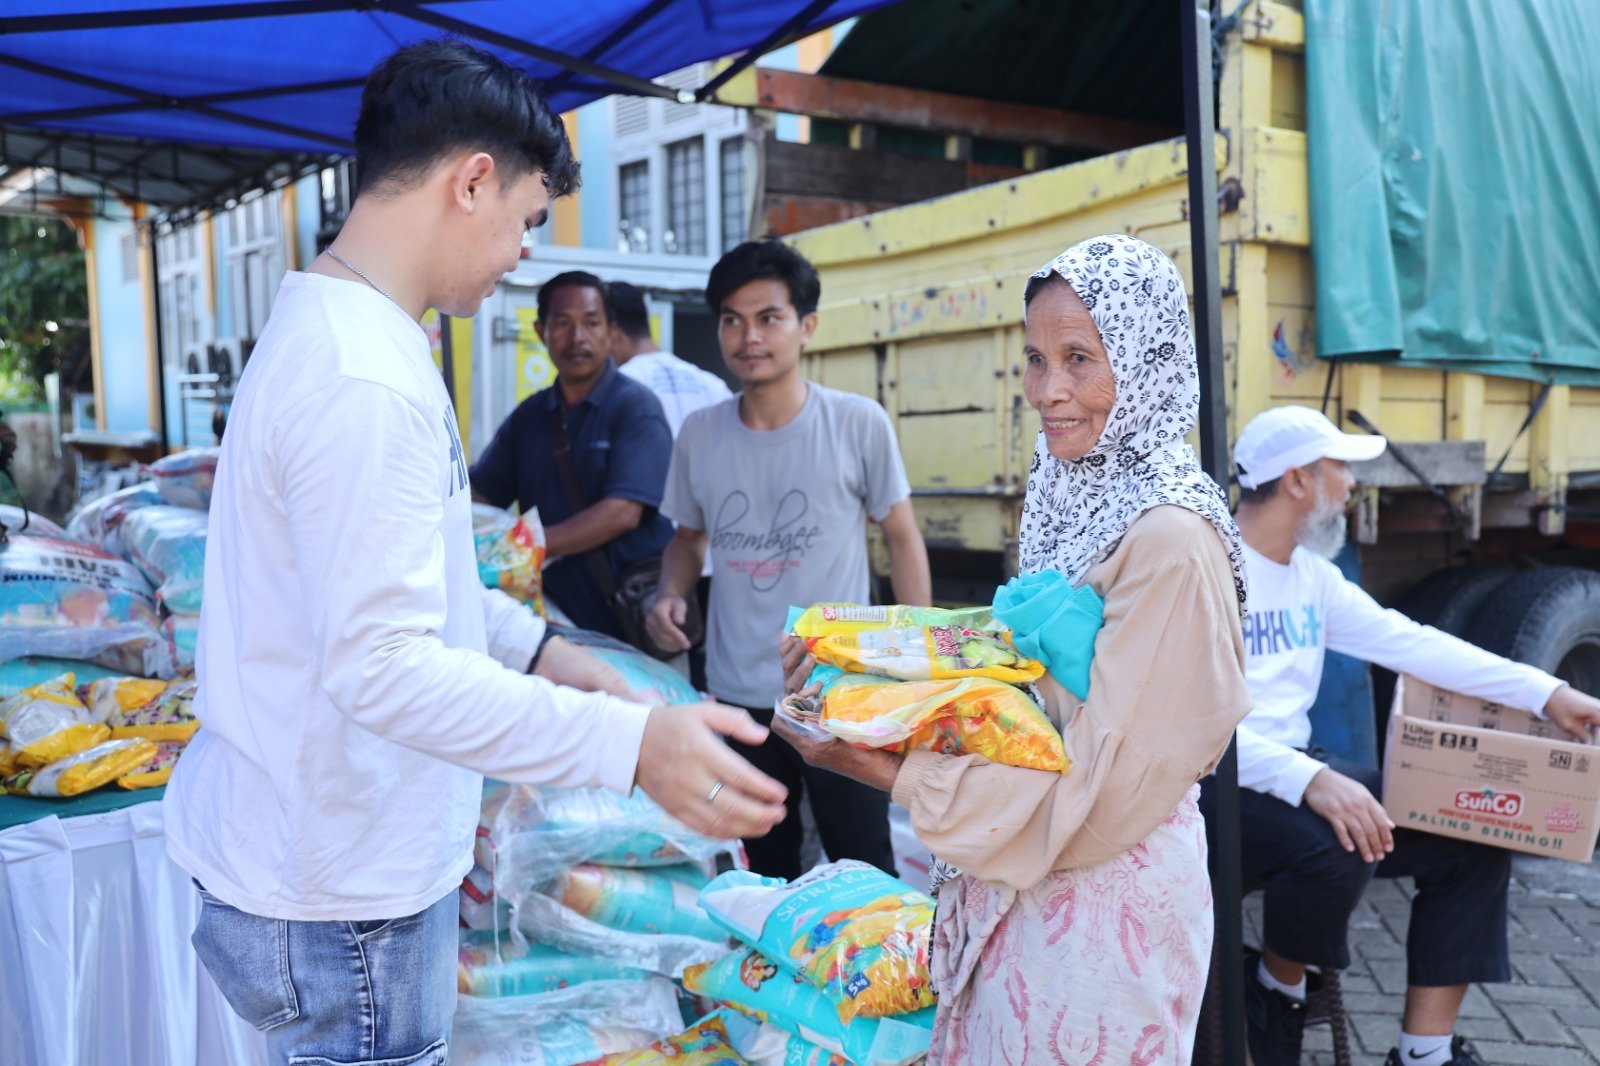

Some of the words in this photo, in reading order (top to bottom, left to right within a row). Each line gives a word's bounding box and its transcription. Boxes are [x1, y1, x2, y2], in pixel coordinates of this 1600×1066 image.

[1457, 792, 1518, 815] SunCo
[1408, 810, 1471, 833] PALING
[776, 879, 841, 922] SETRA
